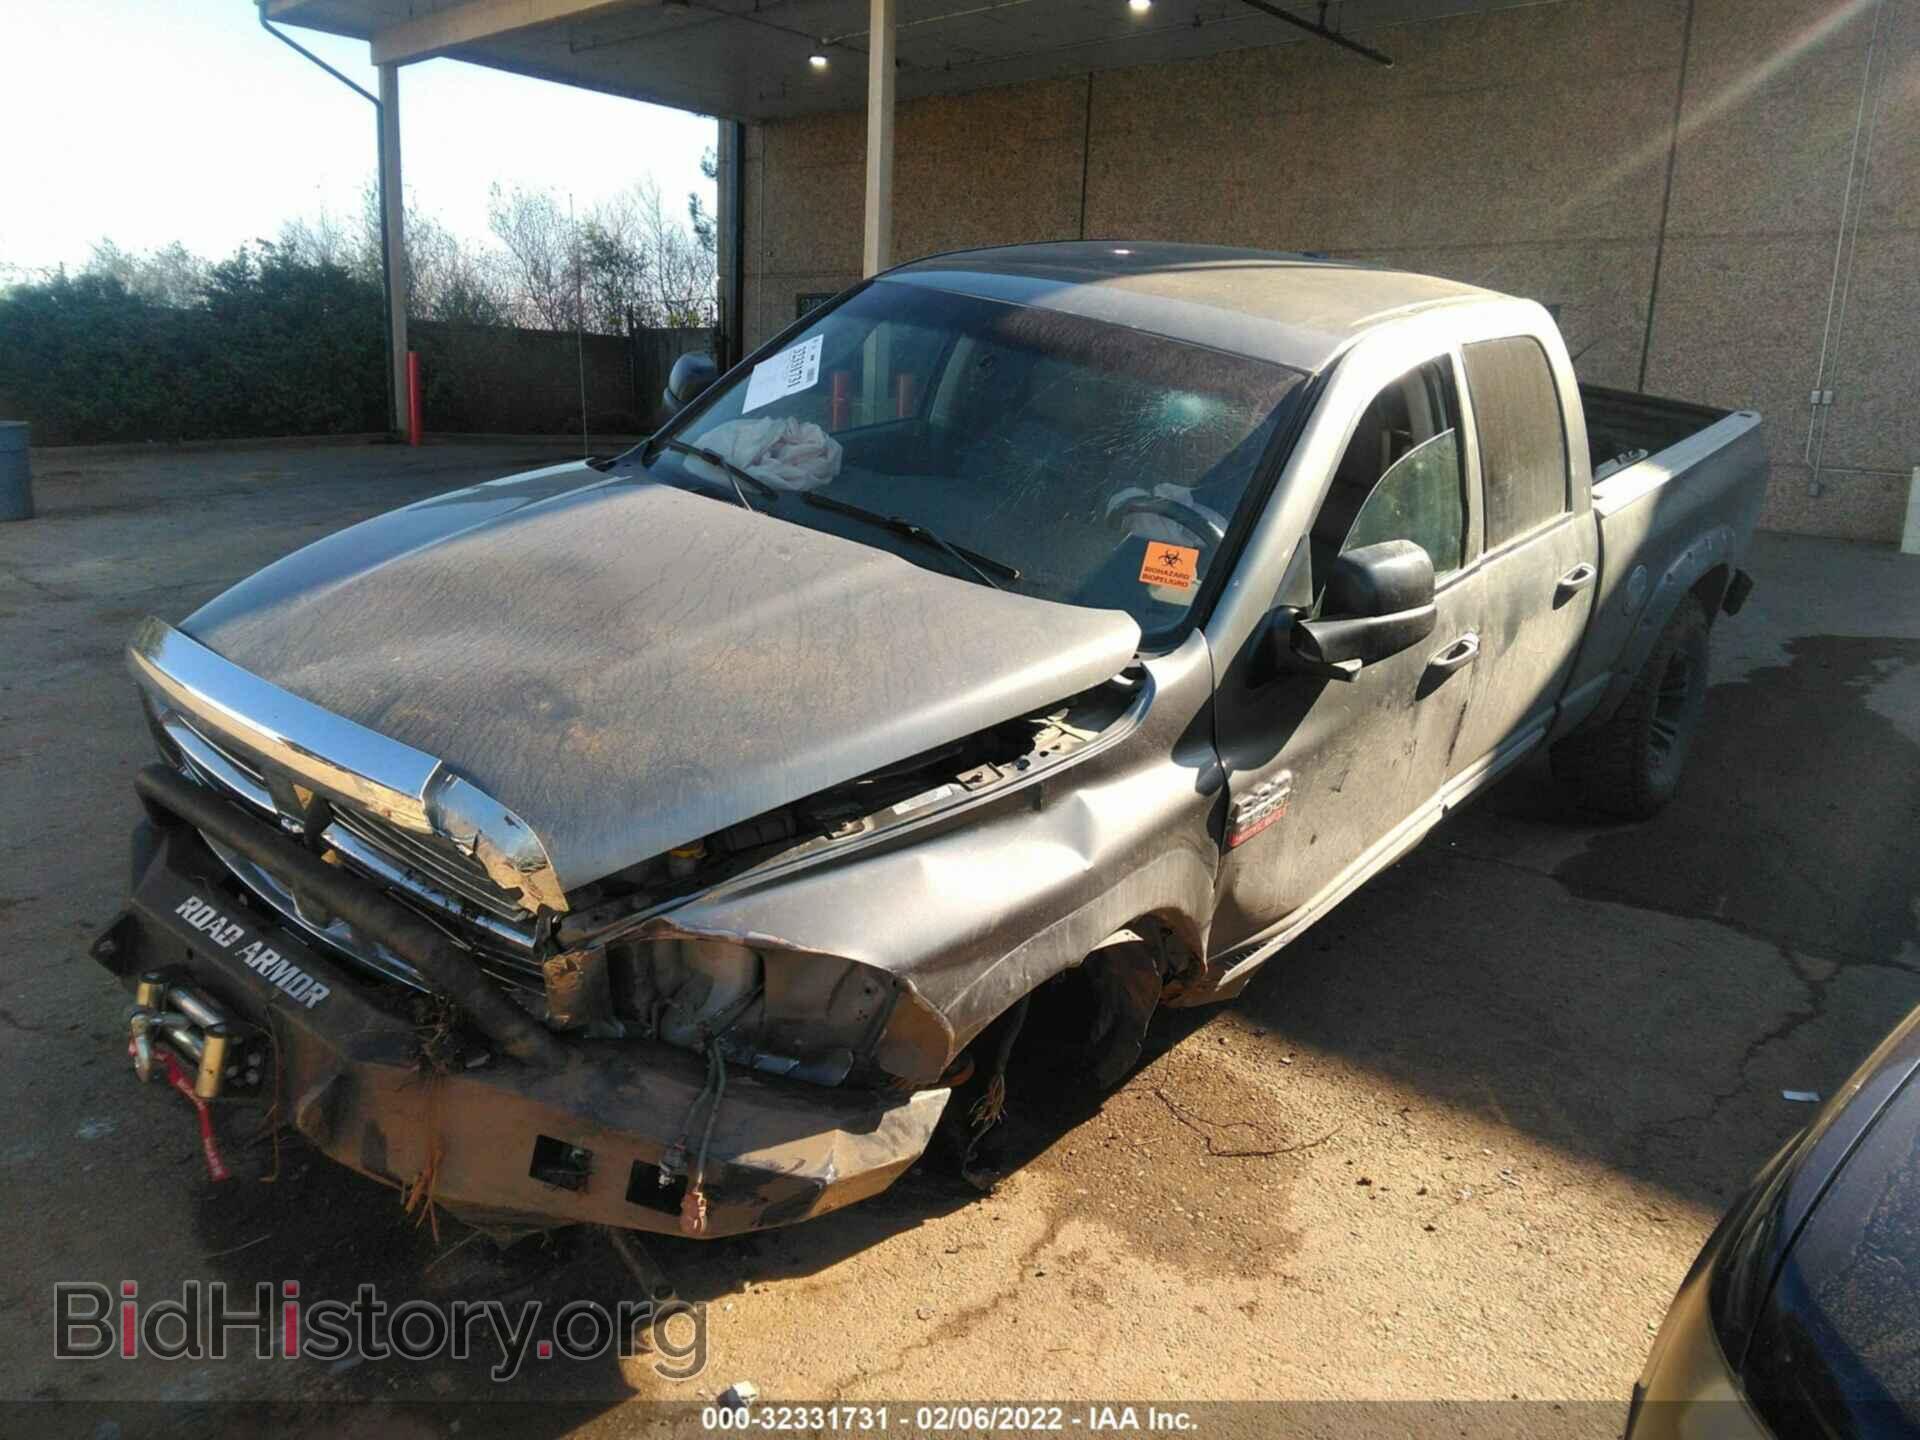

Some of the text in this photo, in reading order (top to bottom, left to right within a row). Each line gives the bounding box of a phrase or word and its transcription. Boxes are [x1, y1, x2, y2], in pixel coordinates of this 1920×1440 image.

[1143, 566, 1190, 580] BIOHAZARD
[175, 896, 331, 1009] ROAD ARMOR
